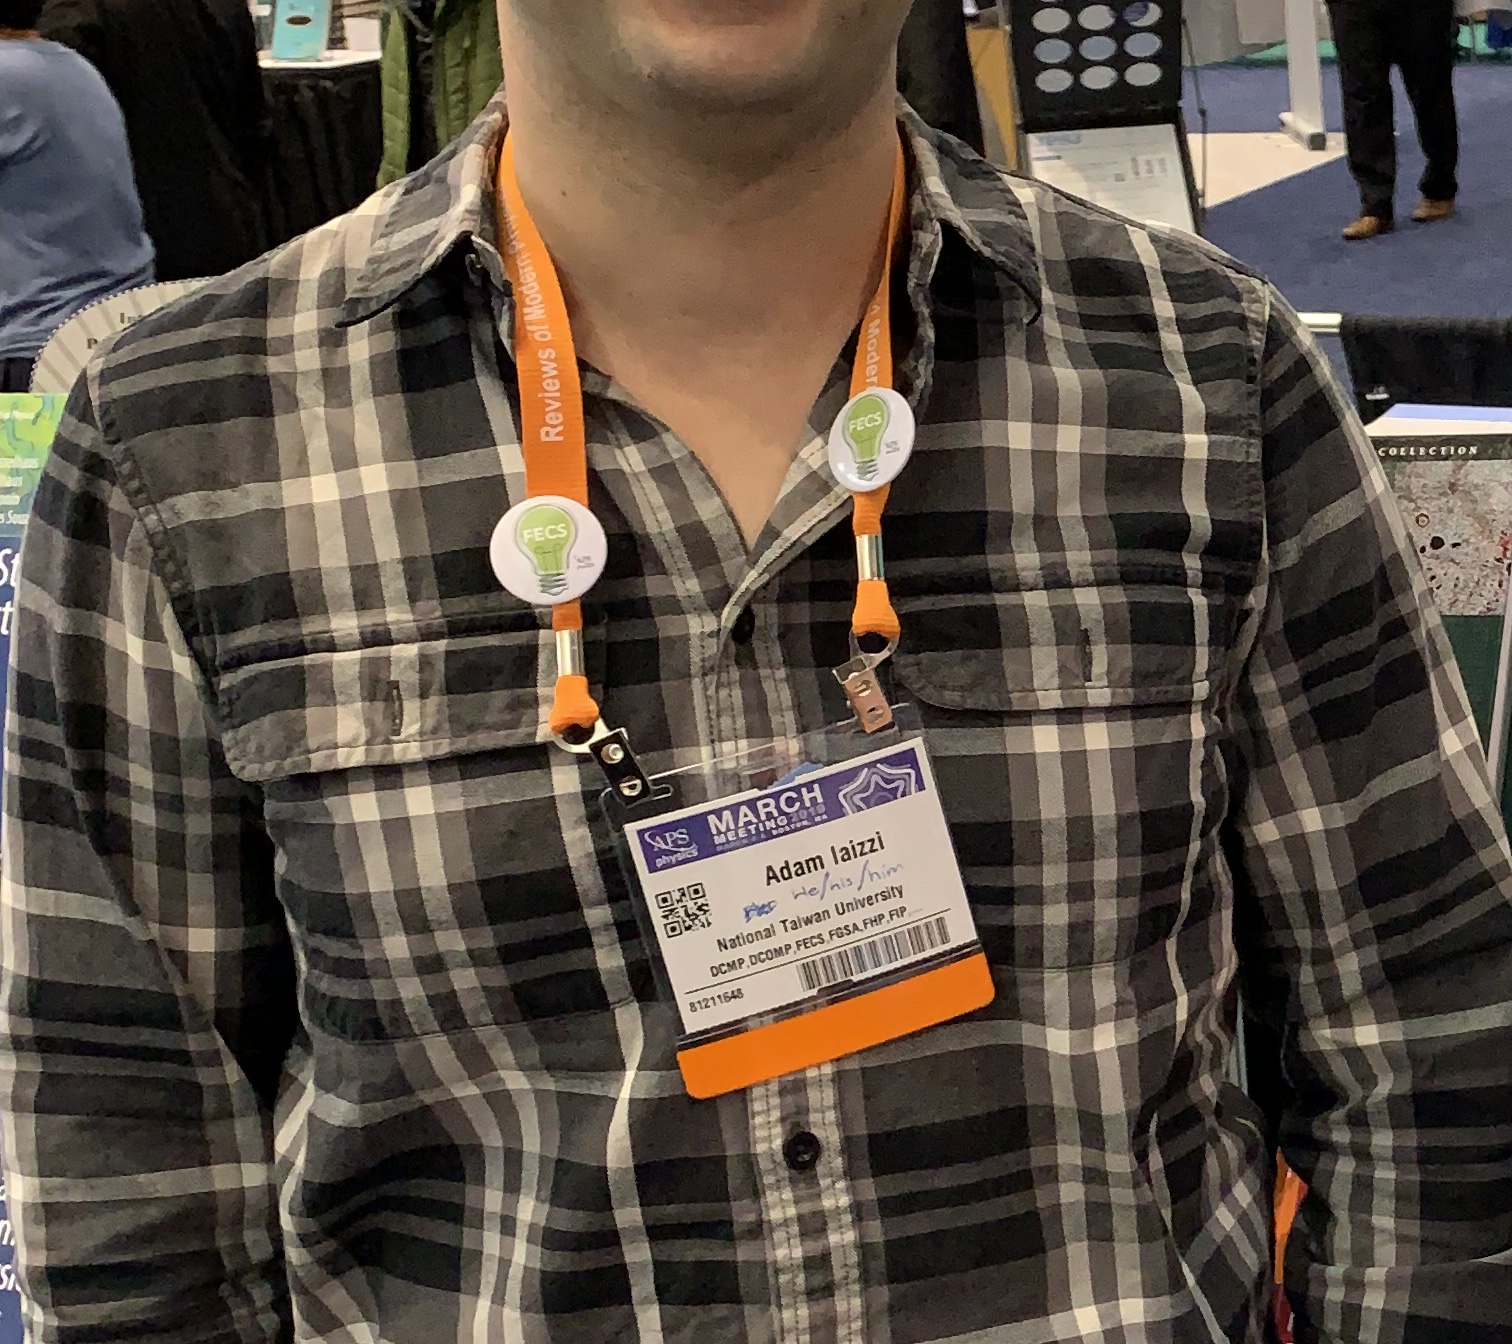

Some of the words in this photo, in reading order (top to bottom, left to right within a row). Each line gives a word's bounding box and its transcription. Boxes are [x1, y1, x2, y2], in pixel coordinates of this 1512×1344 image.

[516, 251, 548, 323] Modern
[532, 322, 553, 342] of
[537, 346, 565, 443] Reviews
[849, 411, 883, 434] FECS
[1378, 444, 1480, 459] COLLECTION
[522, 522, 568, 544] FECS
[706, 783, 825, 836] MARCH
[652, 828, 692, 852] APS
[713, 816, 789, 845] MEETING
[655, 848, 700, 869] physics
[765, 854, 826, 887] Adam
[829, 831, 886, 865] Iaizzi
[716, 919, 777, 953] National
[780, 910, 832, 933] Taiwan
[834, 884, 905, 916] University
